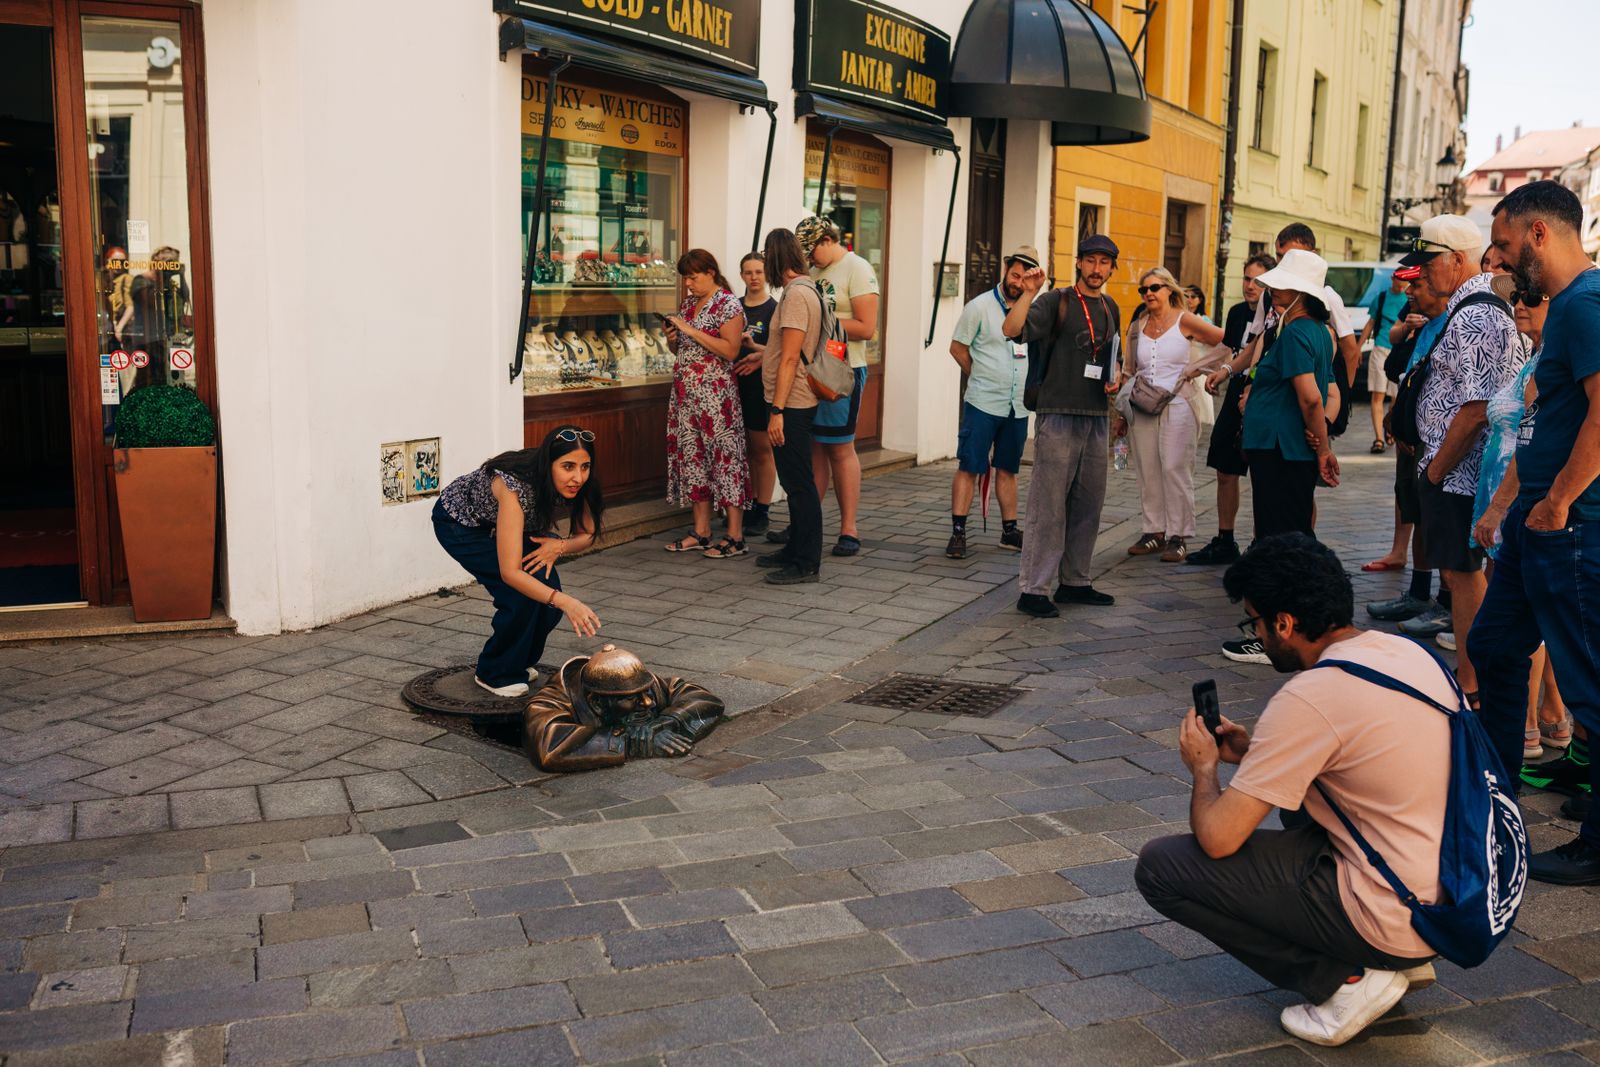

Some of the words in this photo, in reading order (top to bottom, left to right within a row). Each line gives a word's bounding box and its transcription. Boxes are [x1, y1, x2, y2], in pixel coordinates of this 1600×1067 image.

[666, 0, 732, 48] GARNET
[866, 13, 927, 64] EXCLUSIVE
[841, 50, 893, 95] JANTAR
[904, 70, 937, 108] AMBER
[529, 111, 567, 129] SEKO
[599, 94, 681, 129] WATCHES
[655, 140, 678, 149] EDOX
[106, 260, 122, 270] AIR
[123, 261, 181, 271] CONDITIONED
